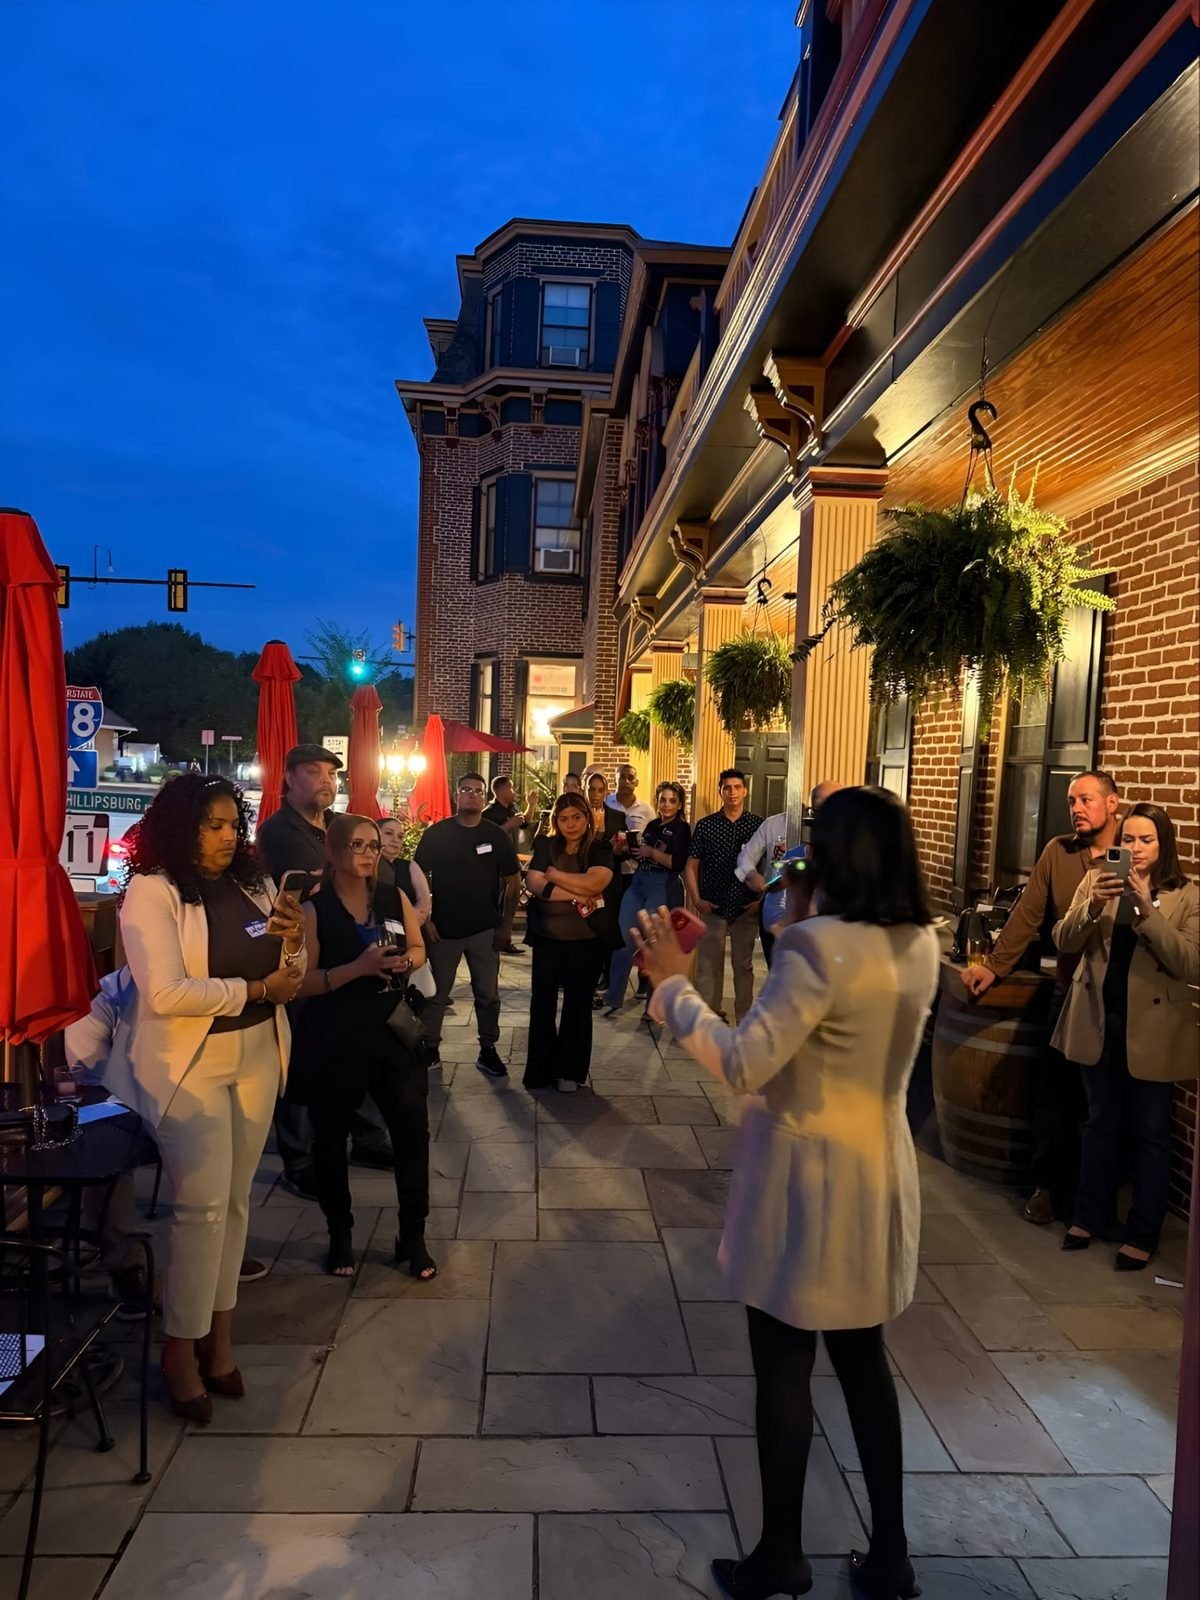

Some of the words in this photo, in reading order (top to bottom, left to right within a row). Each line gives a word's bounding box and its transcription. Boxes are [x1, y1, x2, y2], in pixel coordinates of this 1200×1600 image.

[66, 689, 95, 699] RSTATE
[67, 702, 95, 738] 8
[66, 793, 142, 811] HILLIPSBURG
